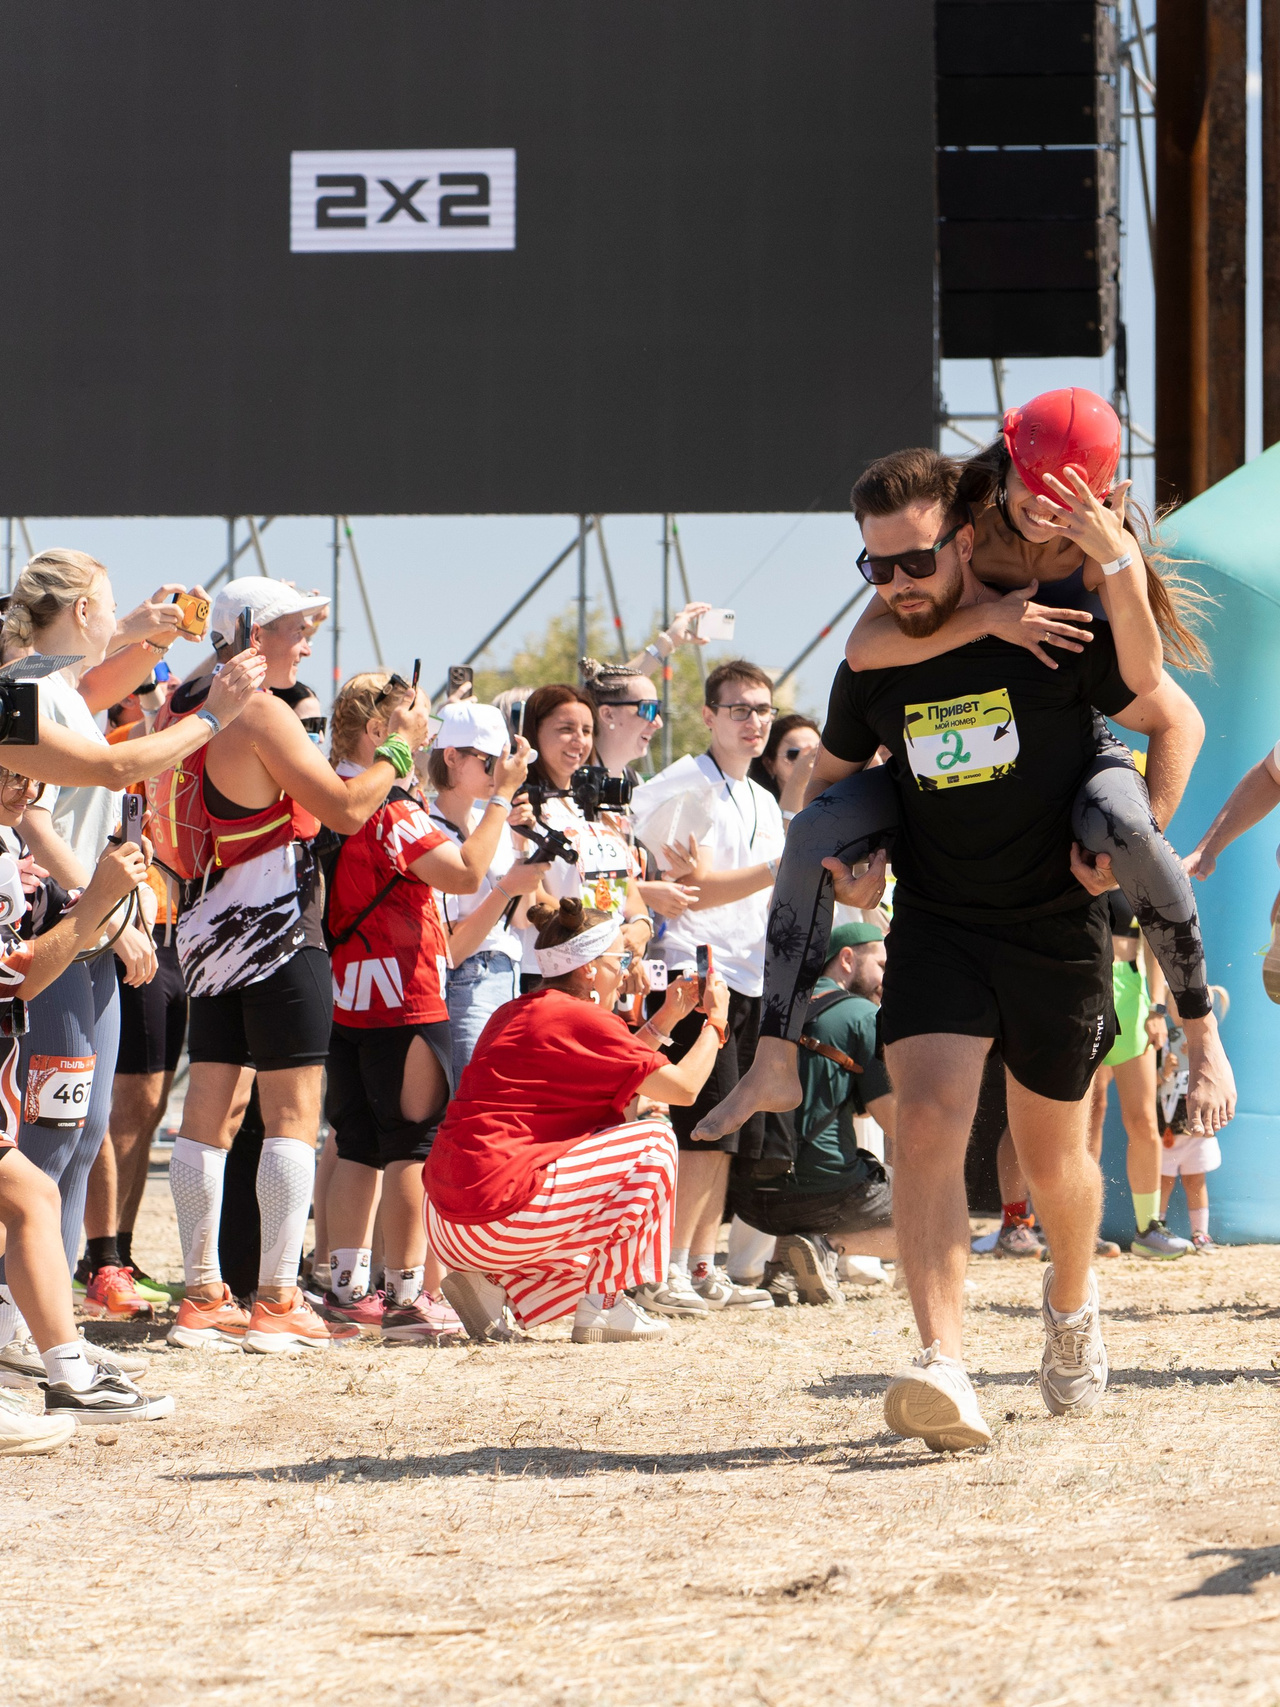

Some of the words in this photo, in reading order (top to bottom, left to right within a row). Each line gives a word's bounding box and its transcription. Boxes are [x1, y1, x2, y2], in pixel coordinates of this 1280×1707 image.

[927, 700, 980, 722] Привет
[935, 720, 950, 731] мой
[950, 716, 977, 728] номер
[936, 729, 972, 770] 2
[1089, 1043, 1100, 1060] LIFE
[1095, 1014, 1104, 1041] STYLE
[60, 1060, 85, 1069] ПЫЛЬ
[53, 1081, 91, 1104] 467
